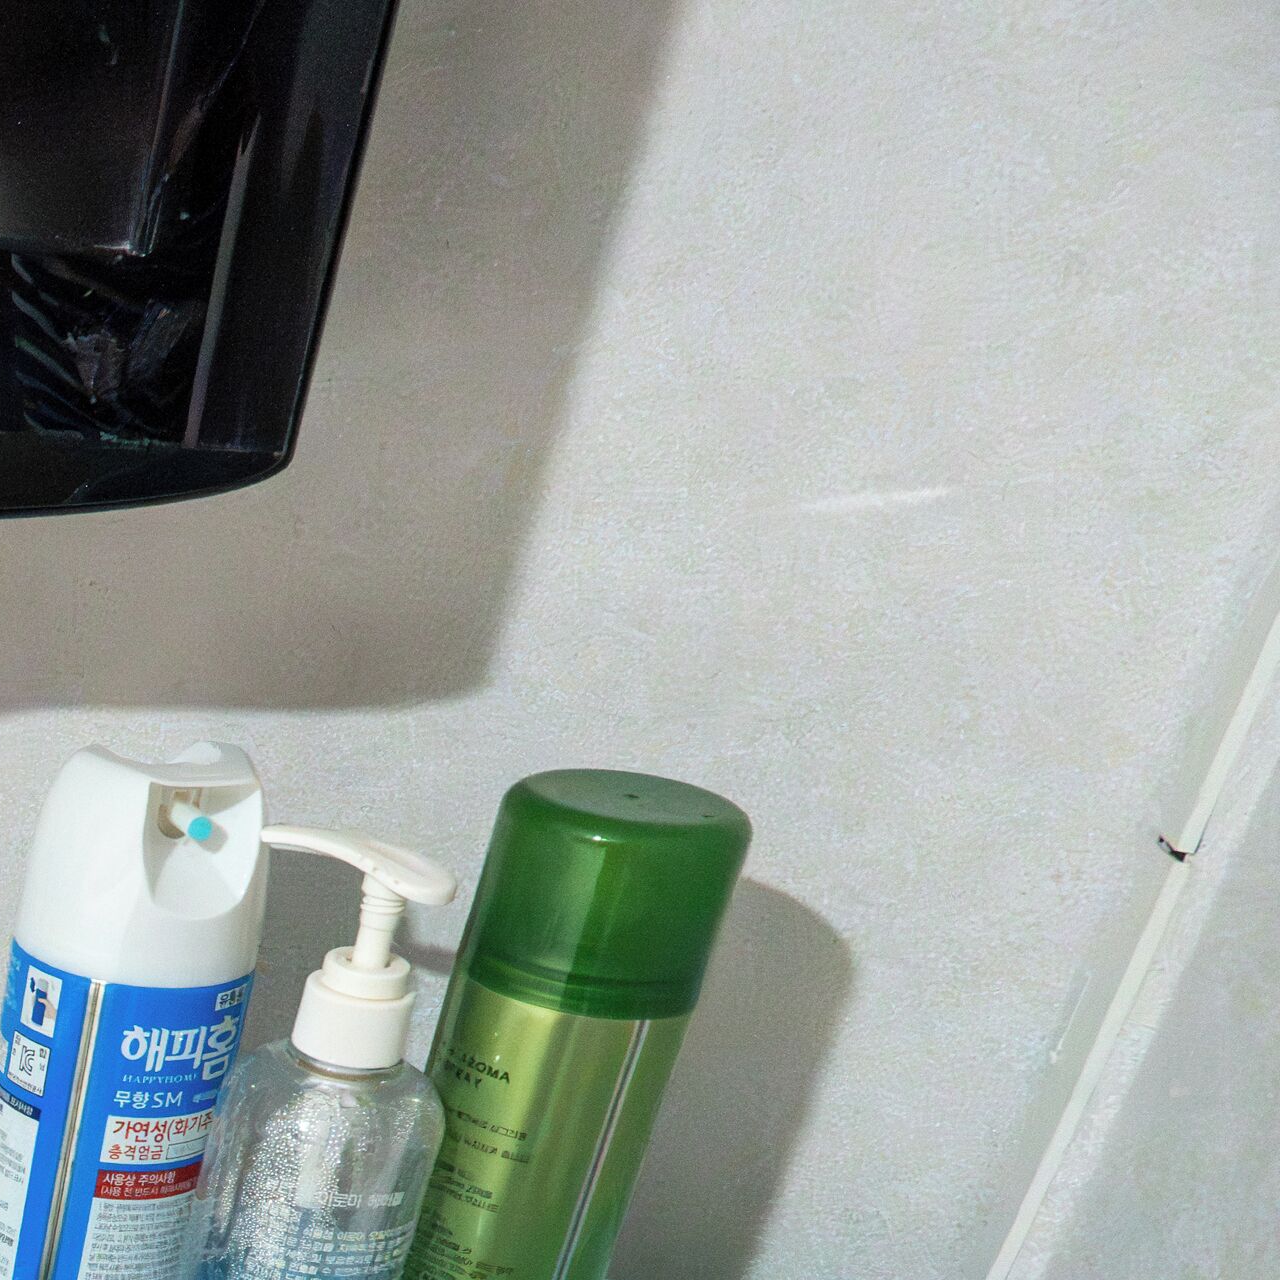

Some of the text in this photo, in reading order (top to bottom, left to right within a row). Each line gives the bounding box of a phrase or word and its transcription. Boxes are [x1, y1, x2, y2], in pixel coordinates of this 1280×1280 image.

[121, 1015, 240, 1081] 해피홈
[113, 1111, 213, 1142] 가연성(화기주
[108, 1143, 163, 1160] 충격엄금
[103, 1171, 176, 1186] 사용상 주의사항
